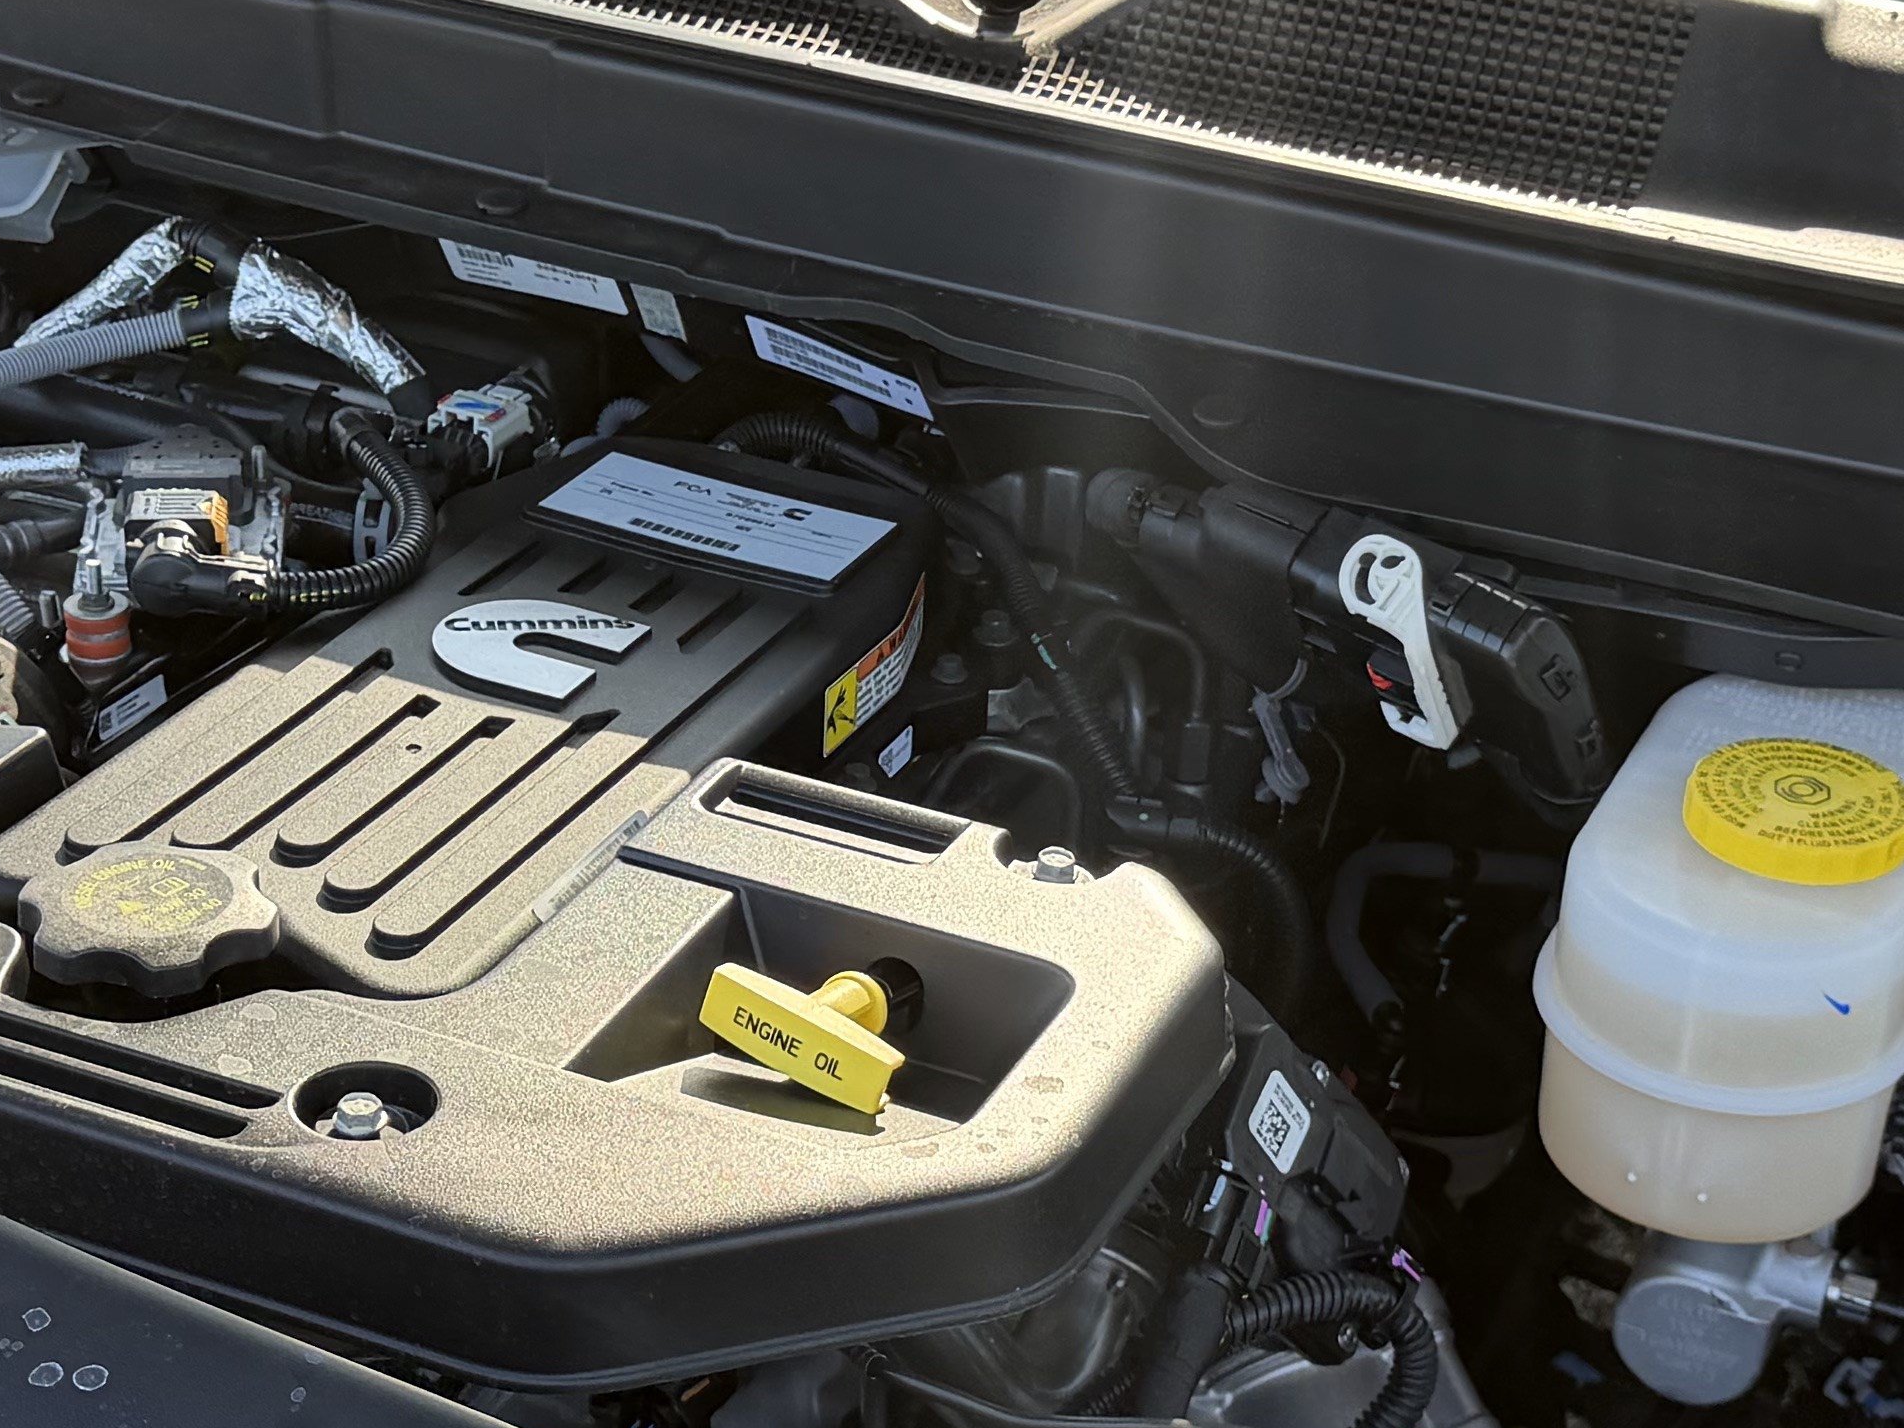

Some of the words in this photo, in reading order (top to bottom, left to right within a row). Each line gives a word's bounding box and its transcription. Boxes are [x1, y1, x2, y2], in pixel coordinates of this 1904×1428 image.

[673, 480, 712, 497] FCA
[443, 613, 637, 634] Cummins
[90, 859, 149, 881] ENGINE
[152, 858, 177, 872] OIL
[733, 1006, 803, 1059] ENGINE
[813, 1051, 844, 1082] OIL
